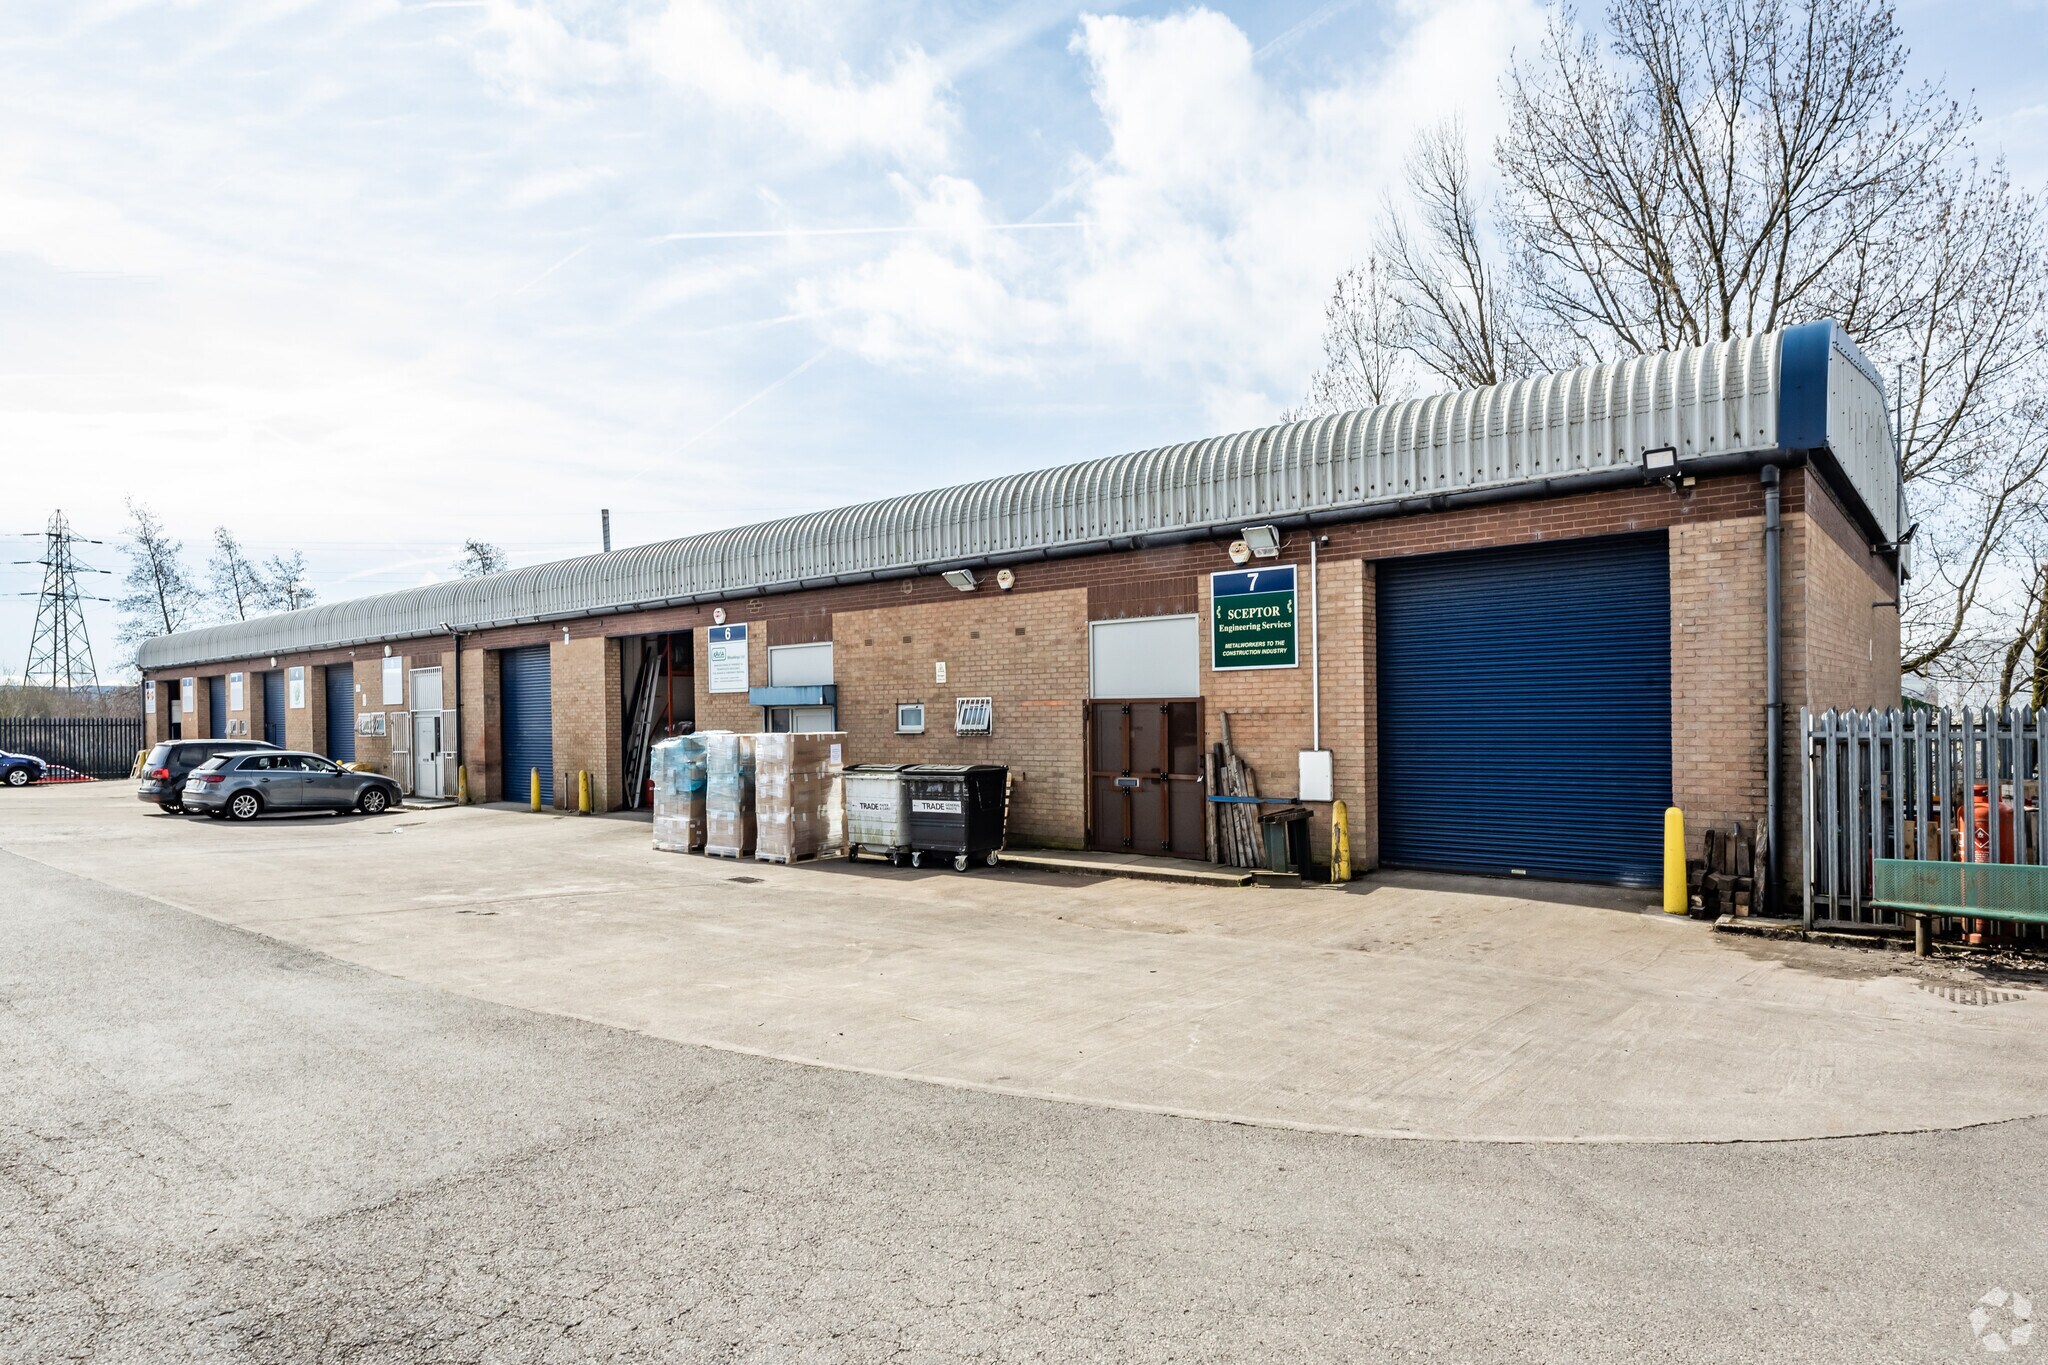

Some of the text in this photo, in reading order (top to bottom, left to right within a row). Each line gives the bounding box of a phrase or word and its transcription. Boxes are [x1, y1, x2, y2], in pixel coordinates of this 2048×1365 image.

[1247, 573, 1259, 592] 7
[1228, 606, 1280, 620] SCEPTOR
[1219, 621, 1291, 633] Engineering Services
[725, 627, 731, 640] 6
[1275, 639, 1285, 647] THE
[1222, 647, 1288, 657] CONSTRUCTION INDUSTRY
[860, 802, 879, 811] TRADE
[922, 802, 945, 811] TRADE
